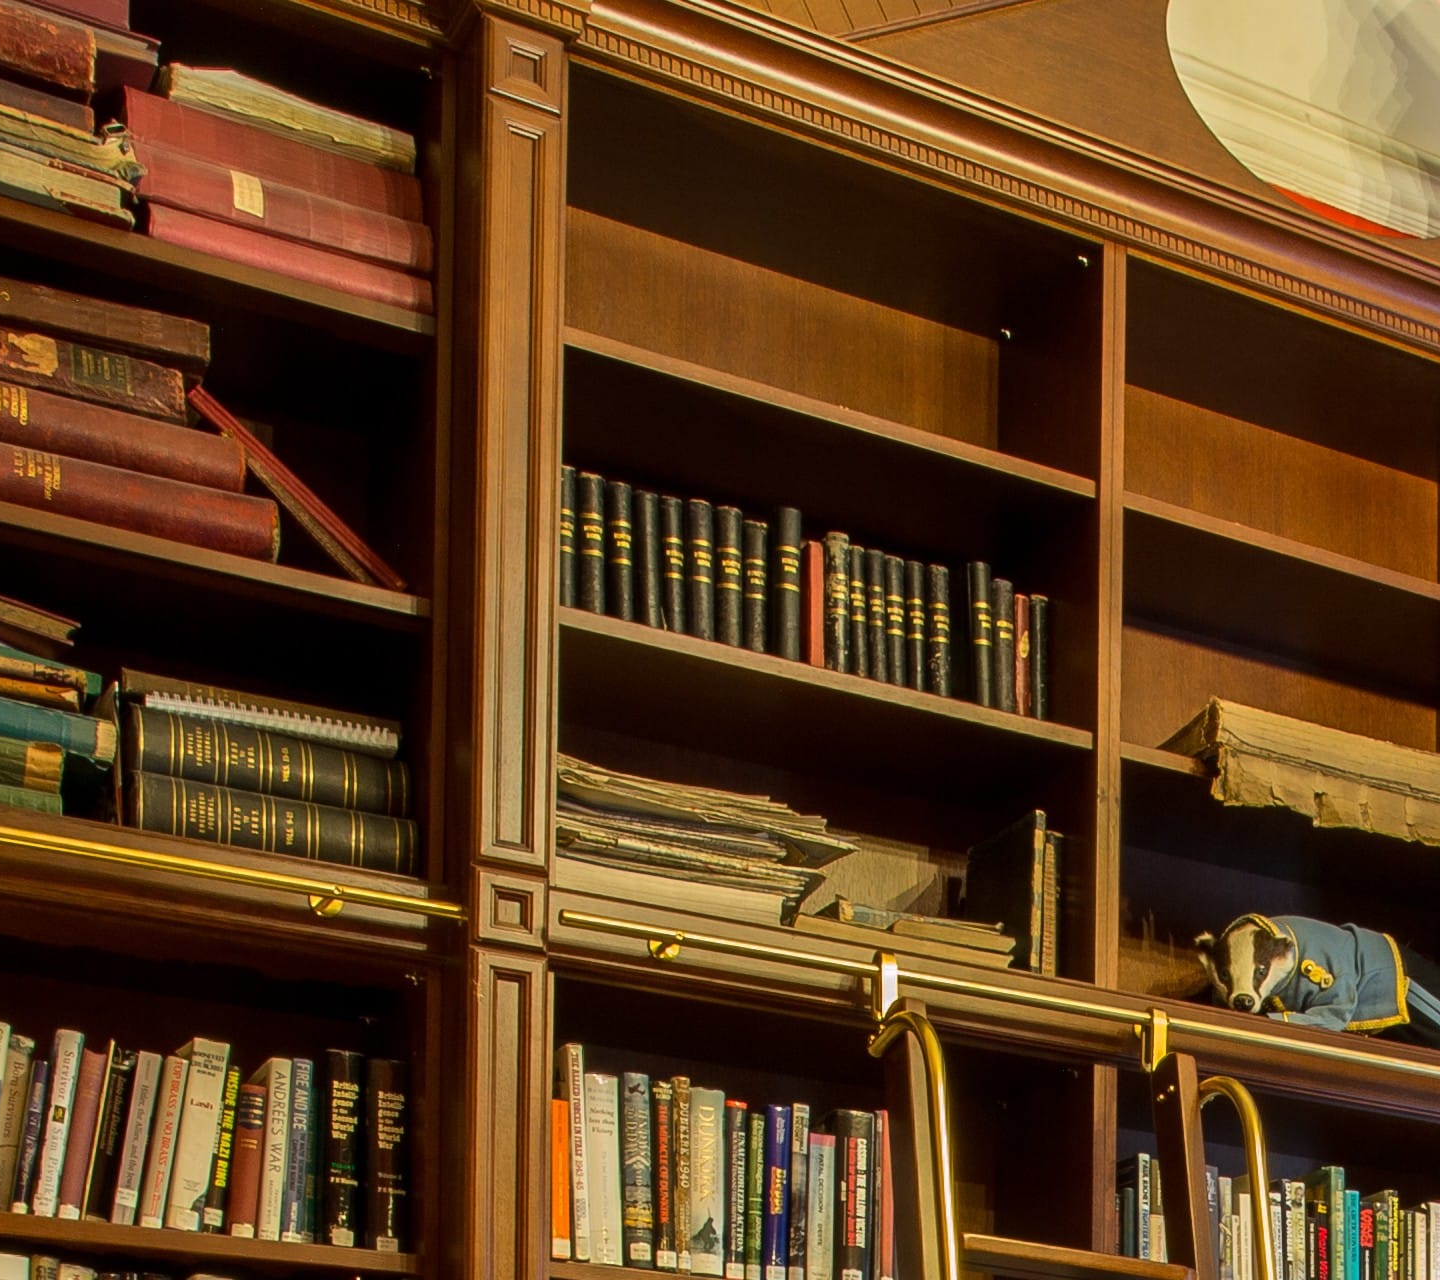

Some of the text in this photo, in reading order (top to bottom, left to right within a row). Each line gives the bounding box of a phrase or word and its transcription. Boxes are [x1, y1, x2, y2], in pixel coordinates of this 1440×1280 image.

[57, 1049, 76, 1110] Survivor
[215, 1071, 239, 1187] INSIDE THE NAZI RING
[268, 1145, 281, 1174] WAR
[699, 1105, 713, 1201] DUNKIRK
